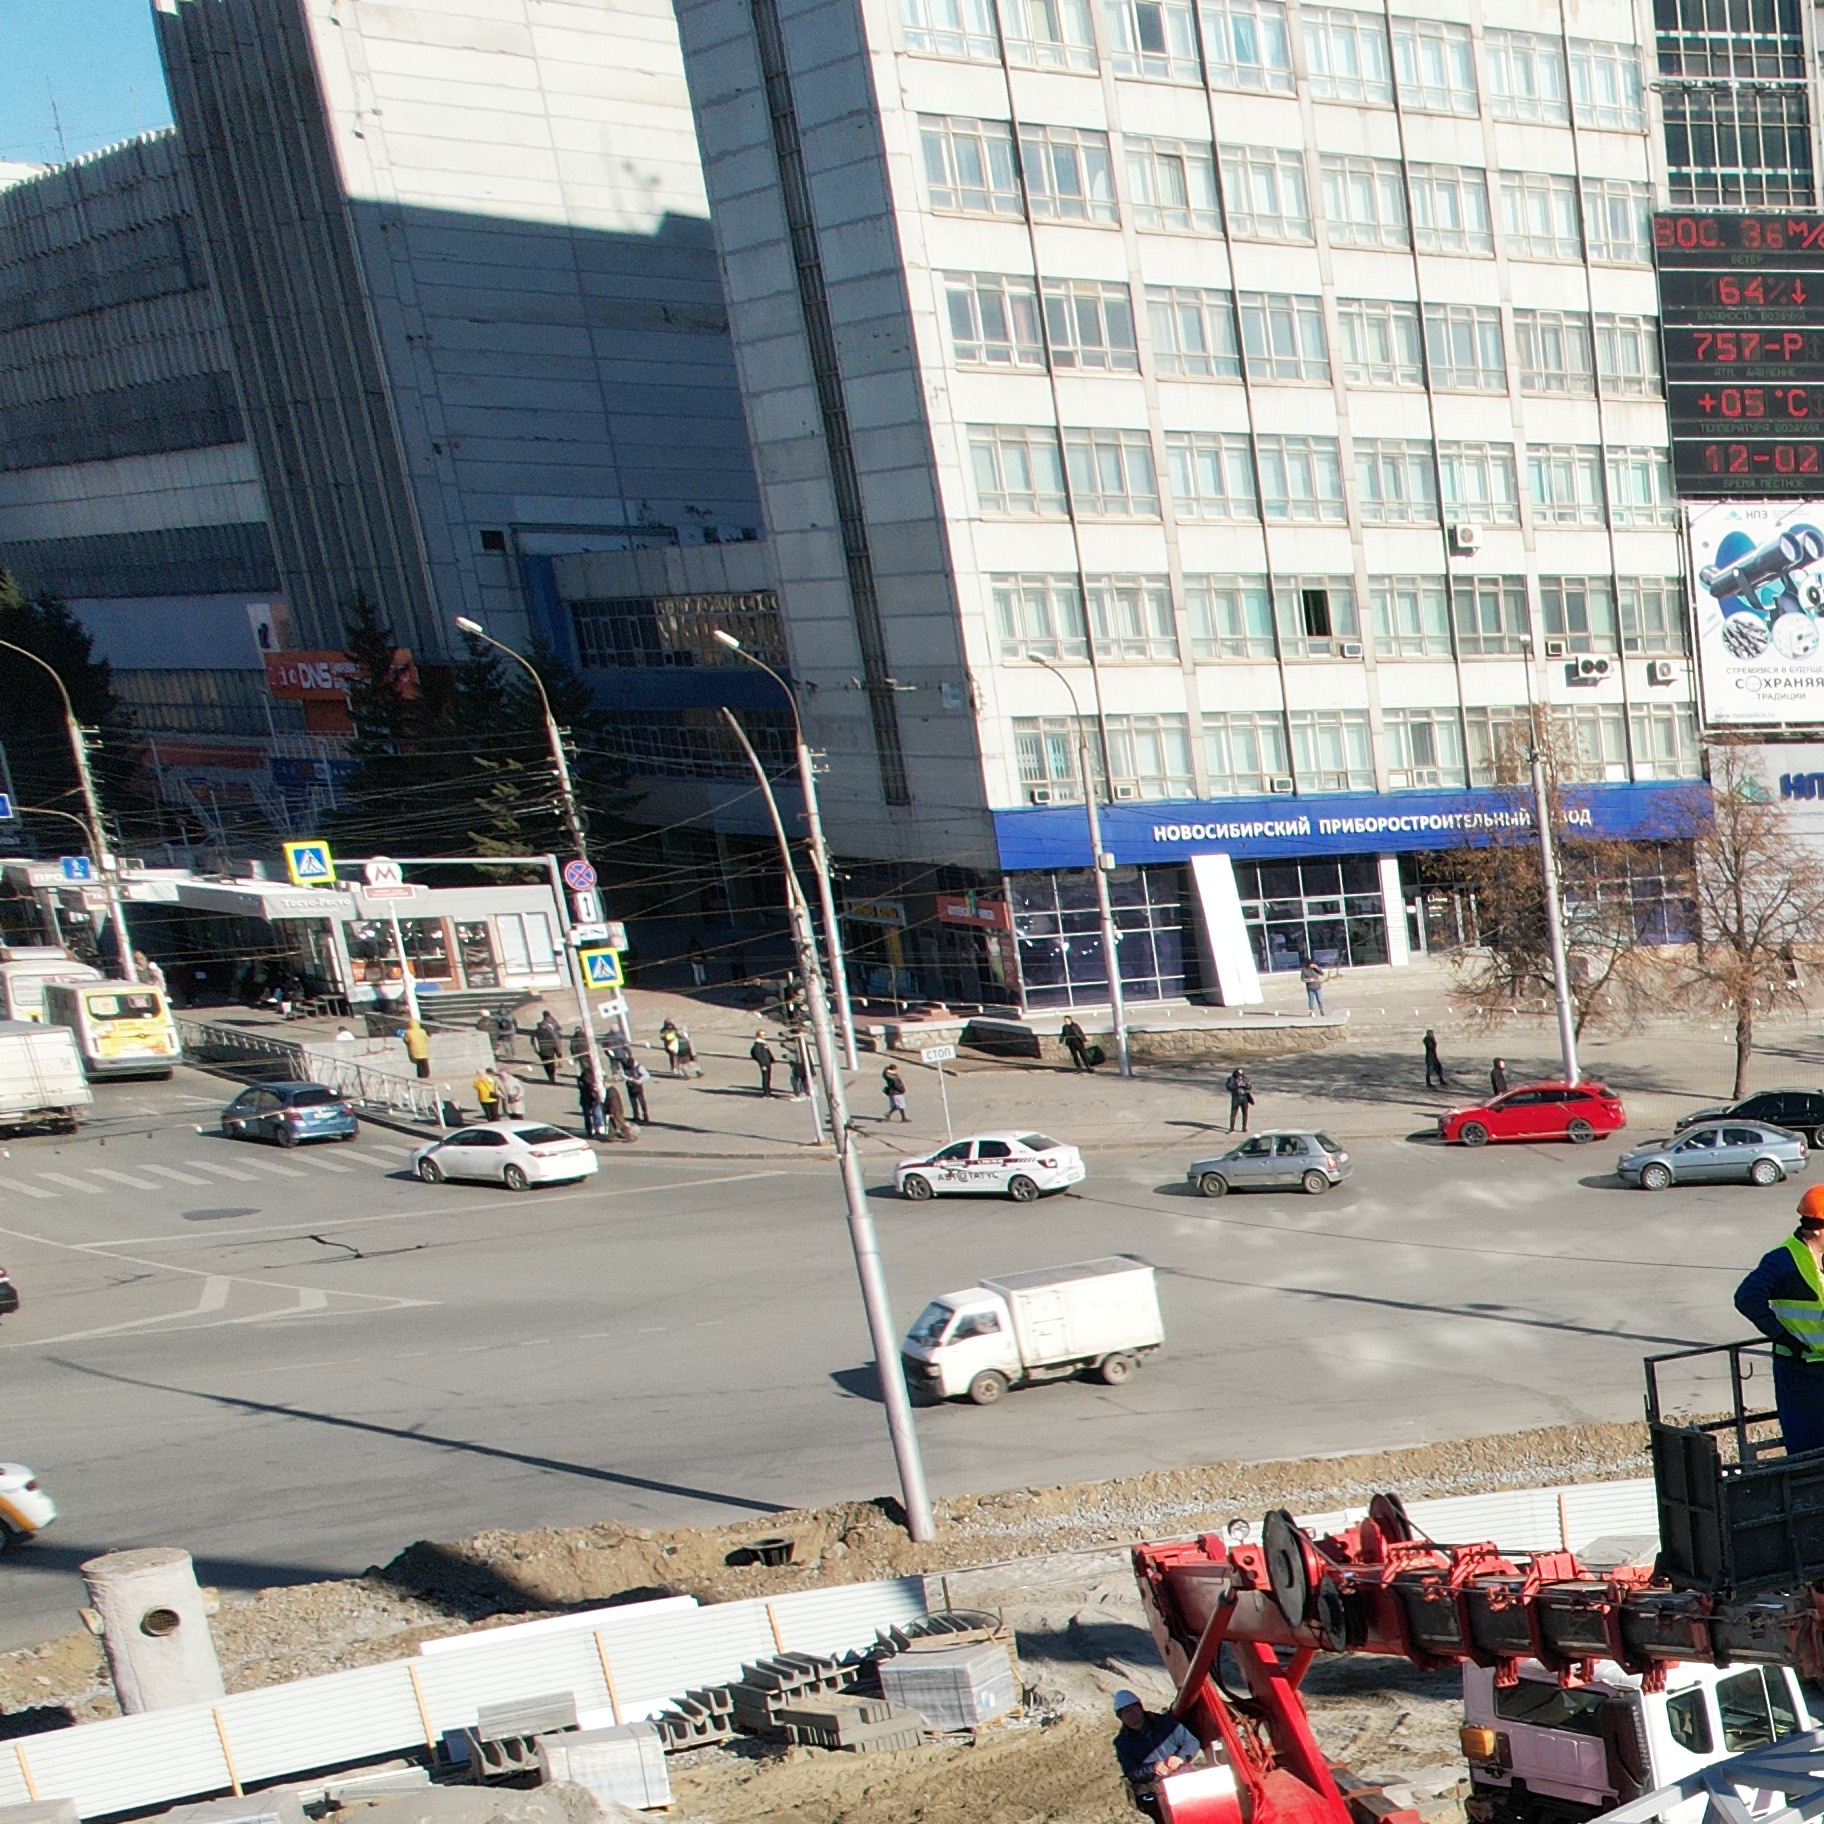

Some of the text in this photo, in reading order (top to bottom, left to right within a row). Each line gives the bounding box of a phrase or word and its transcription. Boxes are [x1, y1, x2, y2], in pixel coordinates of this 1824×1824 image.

[1746, 510, 1768, 519] НПЗ
[298, 662, 332, 689] DNS
[1153, 816, 1311, 842] НОВОСИБИРСКИЙ
[1319, 807, 1531, 835] ПРИБОРОСТРОИТЕЛЬНЫЙ
[926, 1047, 952, 1060] СТОП
